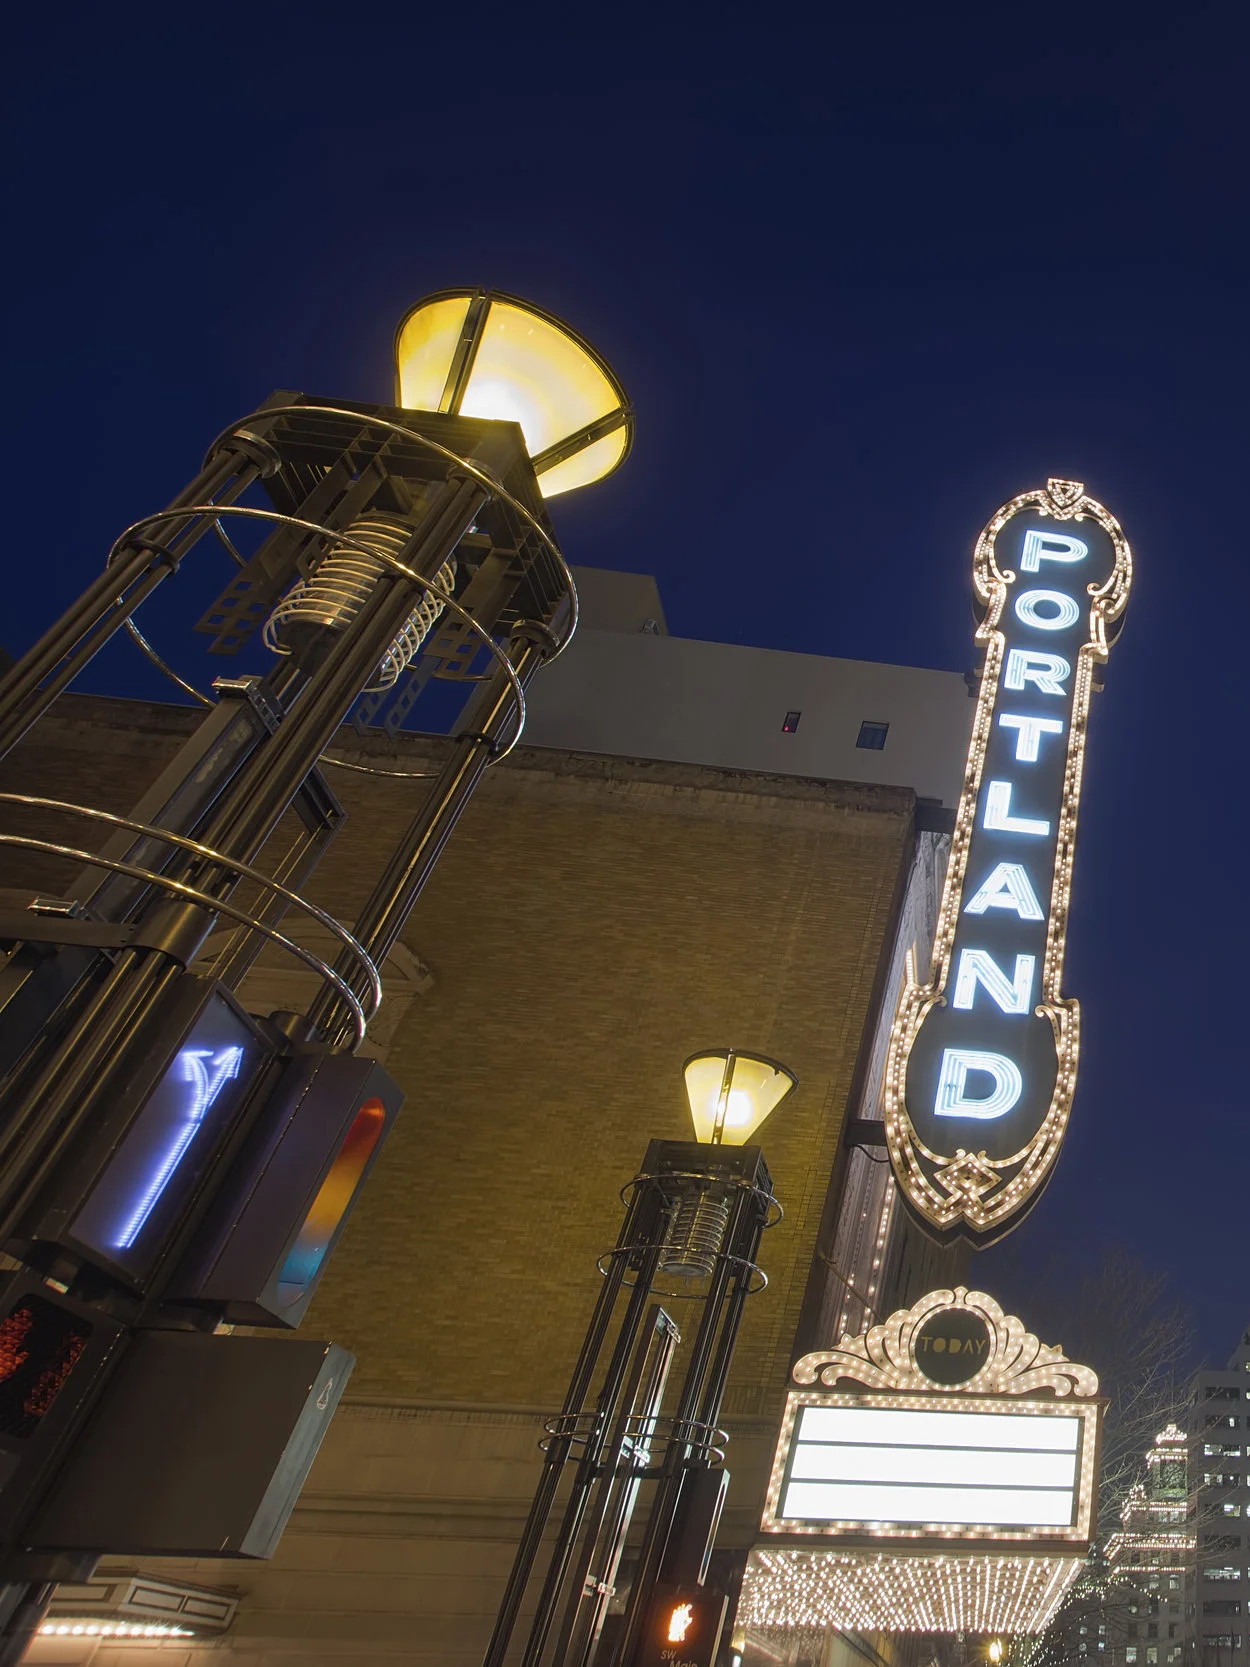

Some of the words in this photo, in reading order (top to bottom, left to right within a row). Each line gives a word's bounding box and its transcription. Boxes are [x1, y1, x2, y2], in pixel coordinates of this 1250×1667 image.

[933, 528, 1089, 1121] PORTLAND
[920, 1336, 986, 1355] TODAY
[660, 1649, 677, 1660] SW
